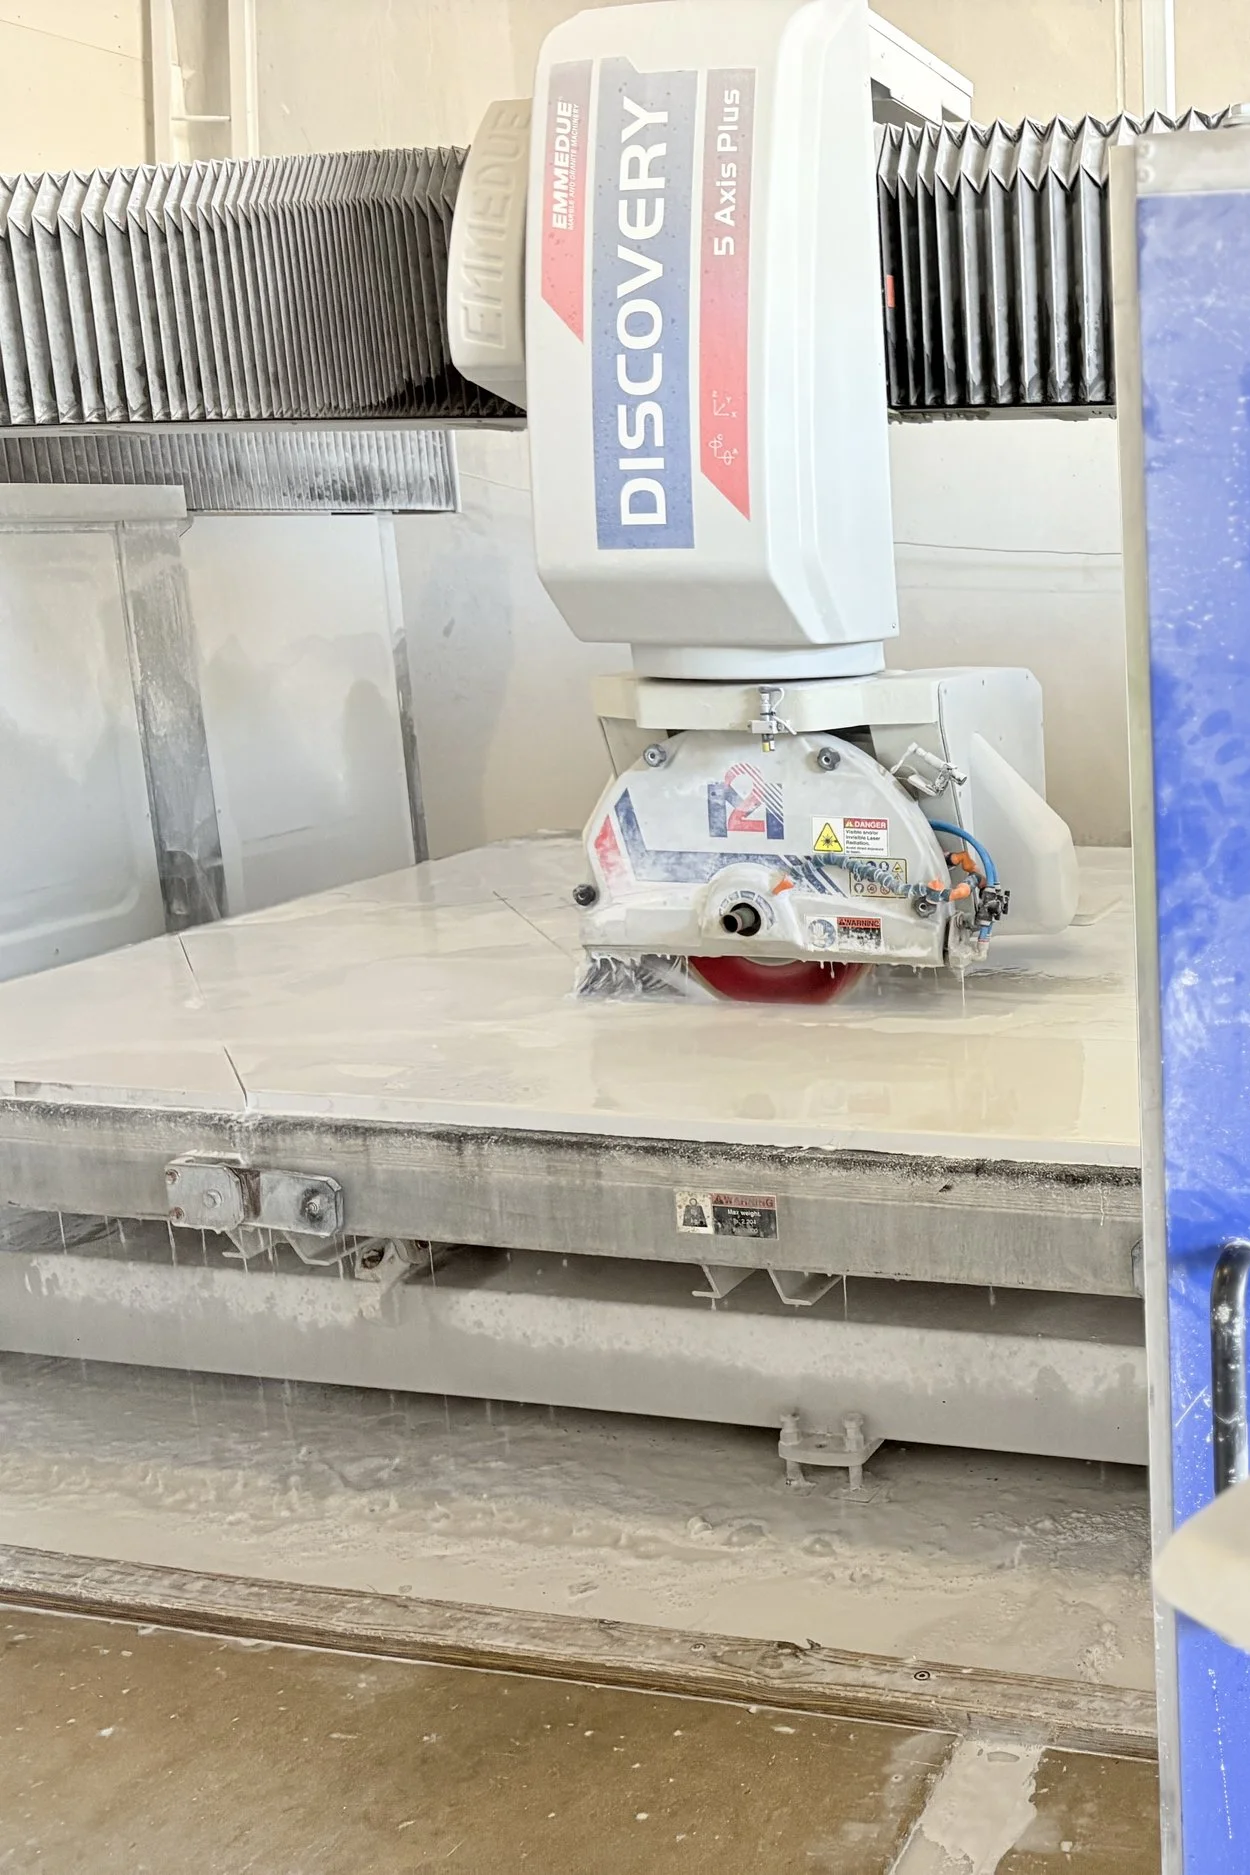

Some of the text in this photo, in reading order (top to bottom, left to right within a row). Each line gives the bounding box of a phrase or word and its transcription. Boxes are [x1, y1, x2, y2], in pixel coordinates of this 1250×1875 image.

[570, 103, 580, 147] MACHINERY
[552, 101, 572, 230] EMMEDUE
[568, 148, 578, 181] GRANITE
[713, 88, 741, 256] 5 Axis Plus
[567, 181, 576, 198] AND
[616, 95, 669, 527] DISCOVERY
[854, 820, 887, 829] DANGER
[844, 919, 880, 927] WARNING
[727, 1208, 739, 1216] Max
